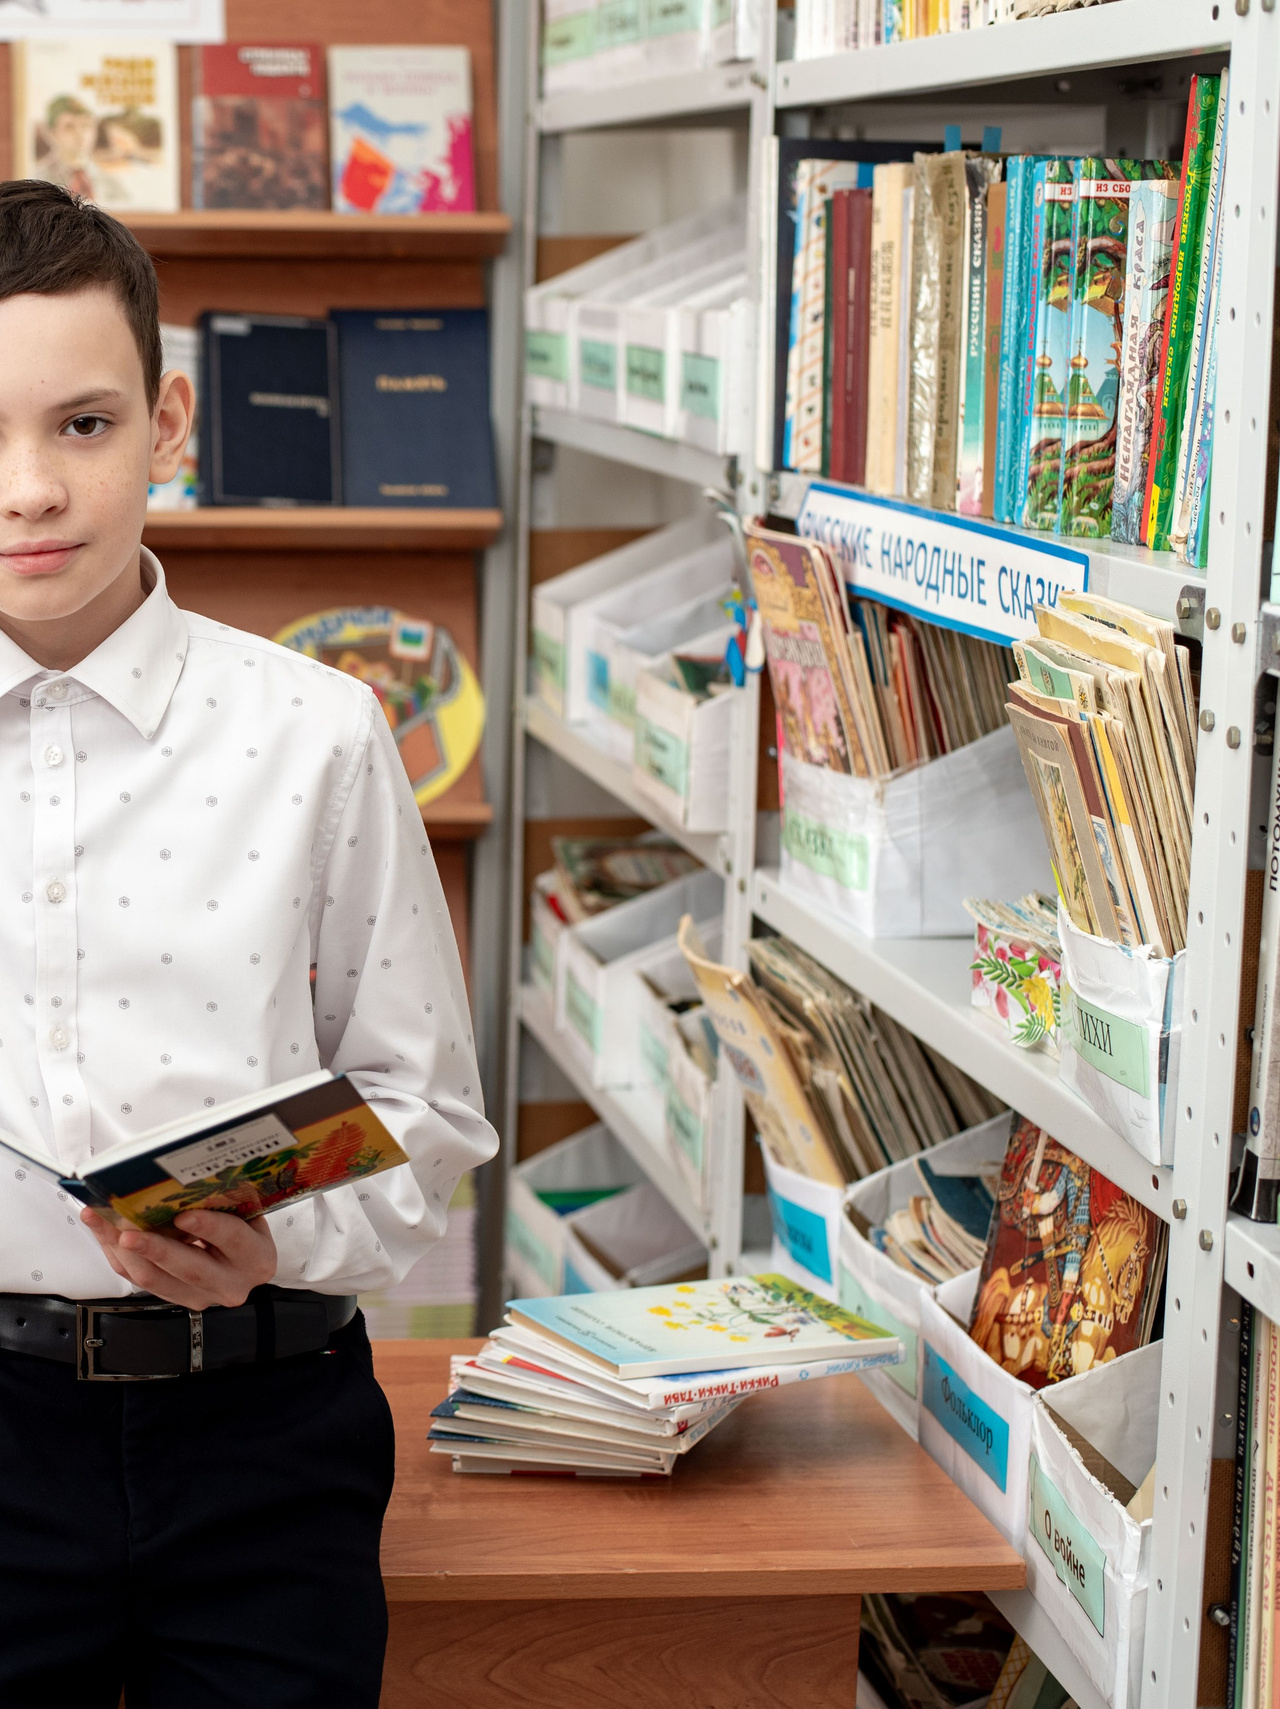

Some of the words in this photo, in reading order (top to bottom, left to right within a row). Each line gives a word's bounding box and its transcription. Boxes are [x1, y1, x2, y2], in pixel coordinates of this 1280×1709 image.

[1112, 184, 1131, 193] СБО
[1179, 167, 1196, 240] Русские
[972, 198, 984, 269] СКАЗКИ
[969, 273, 982, 358] РУССКИЕ
[1169, 245, 1188, 339] народные
[1162, 346, 1175, 408] сказки
[881, 531, 987, 606] НАРОДНЫЕ
[1077, 1006, 1114, 1057] ИХИ
[1241, 1302, 1251, 1356] Земл
[941, 1374, 993, 1455] Фольклор
[1238, 1365, 1248, 1457] планета
[1044, 1509, 1053, 1541] О
[1054, 1536, 1087, 1589] войне
[1232, 1467, 1244, 1565] Чудесная
[1264, 1472, 1274, 1611] ДЕТСКАЯ
